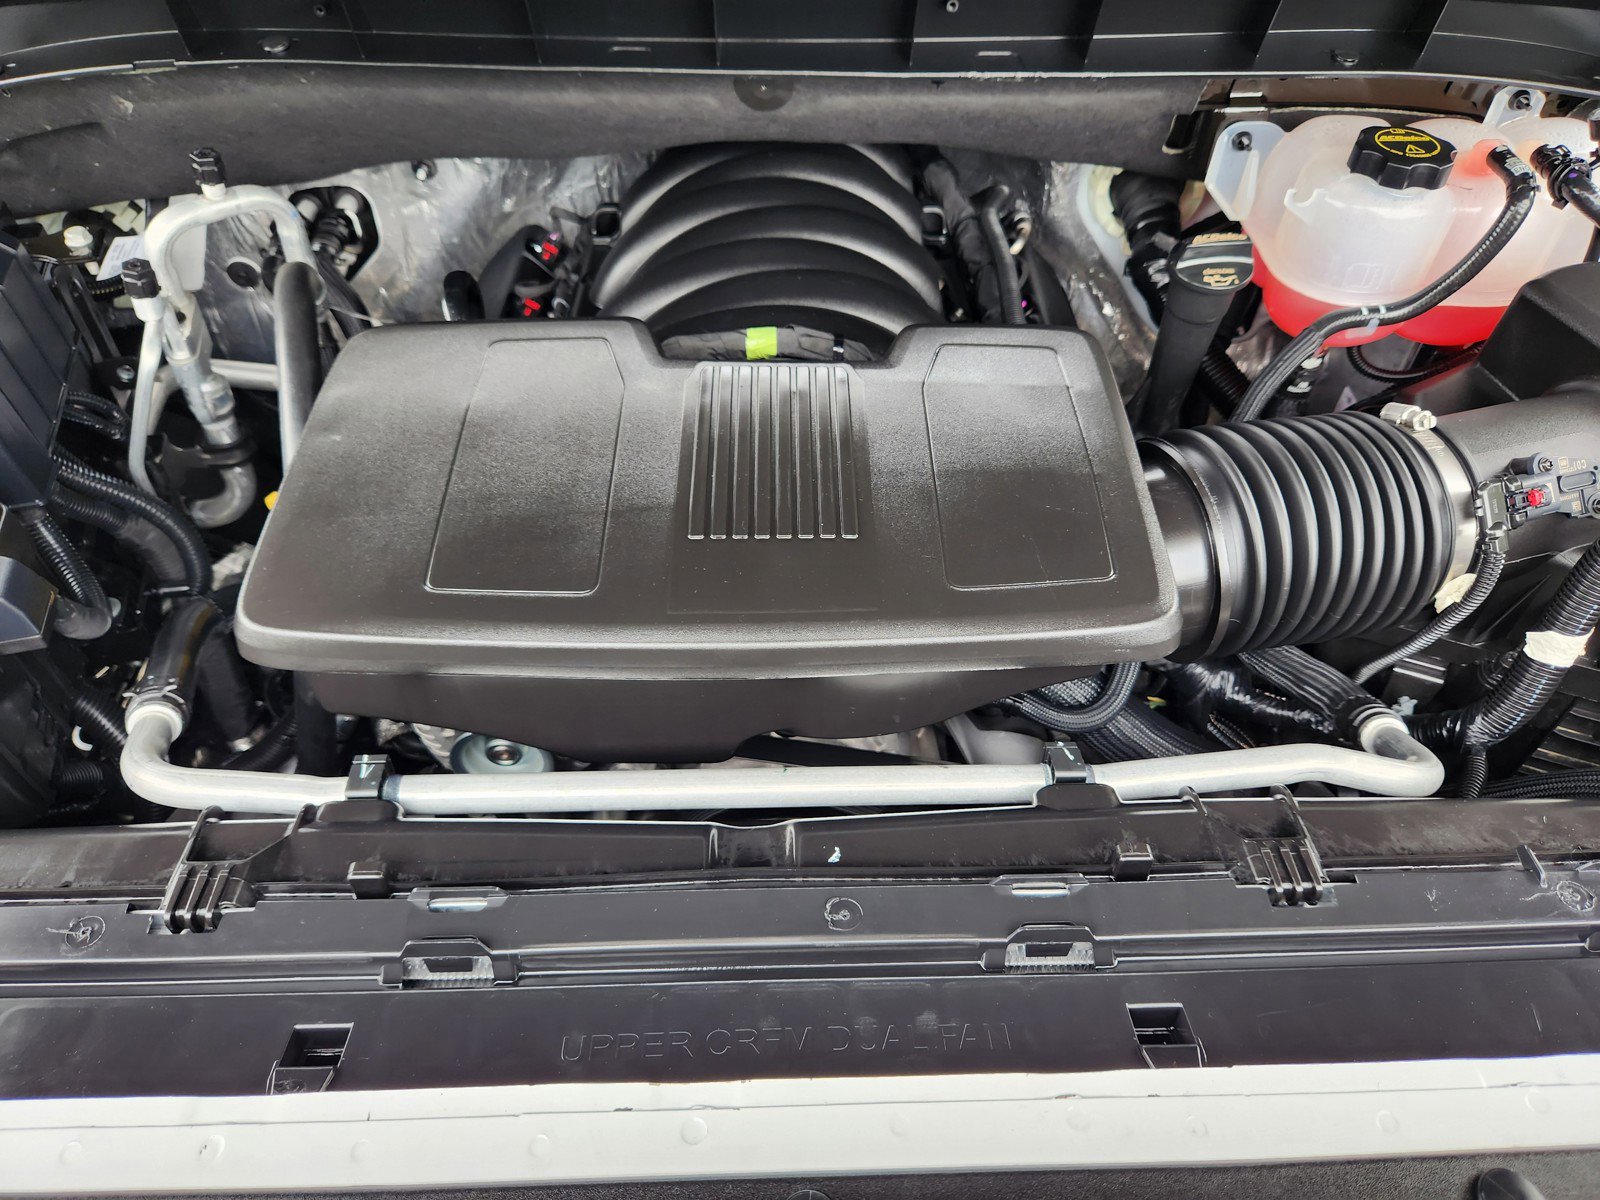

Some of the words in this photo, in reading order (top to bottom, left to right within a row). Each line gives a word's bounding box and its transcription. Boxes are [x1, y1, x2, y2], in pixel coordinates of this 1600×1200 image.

[1192, 232, 1248, 245] ACDelco
[561, 1031, 695, 1061] UPPER
[827, 1024, 929, 1051] DUAL
[937, 1022, 1012, 1051] FAN
